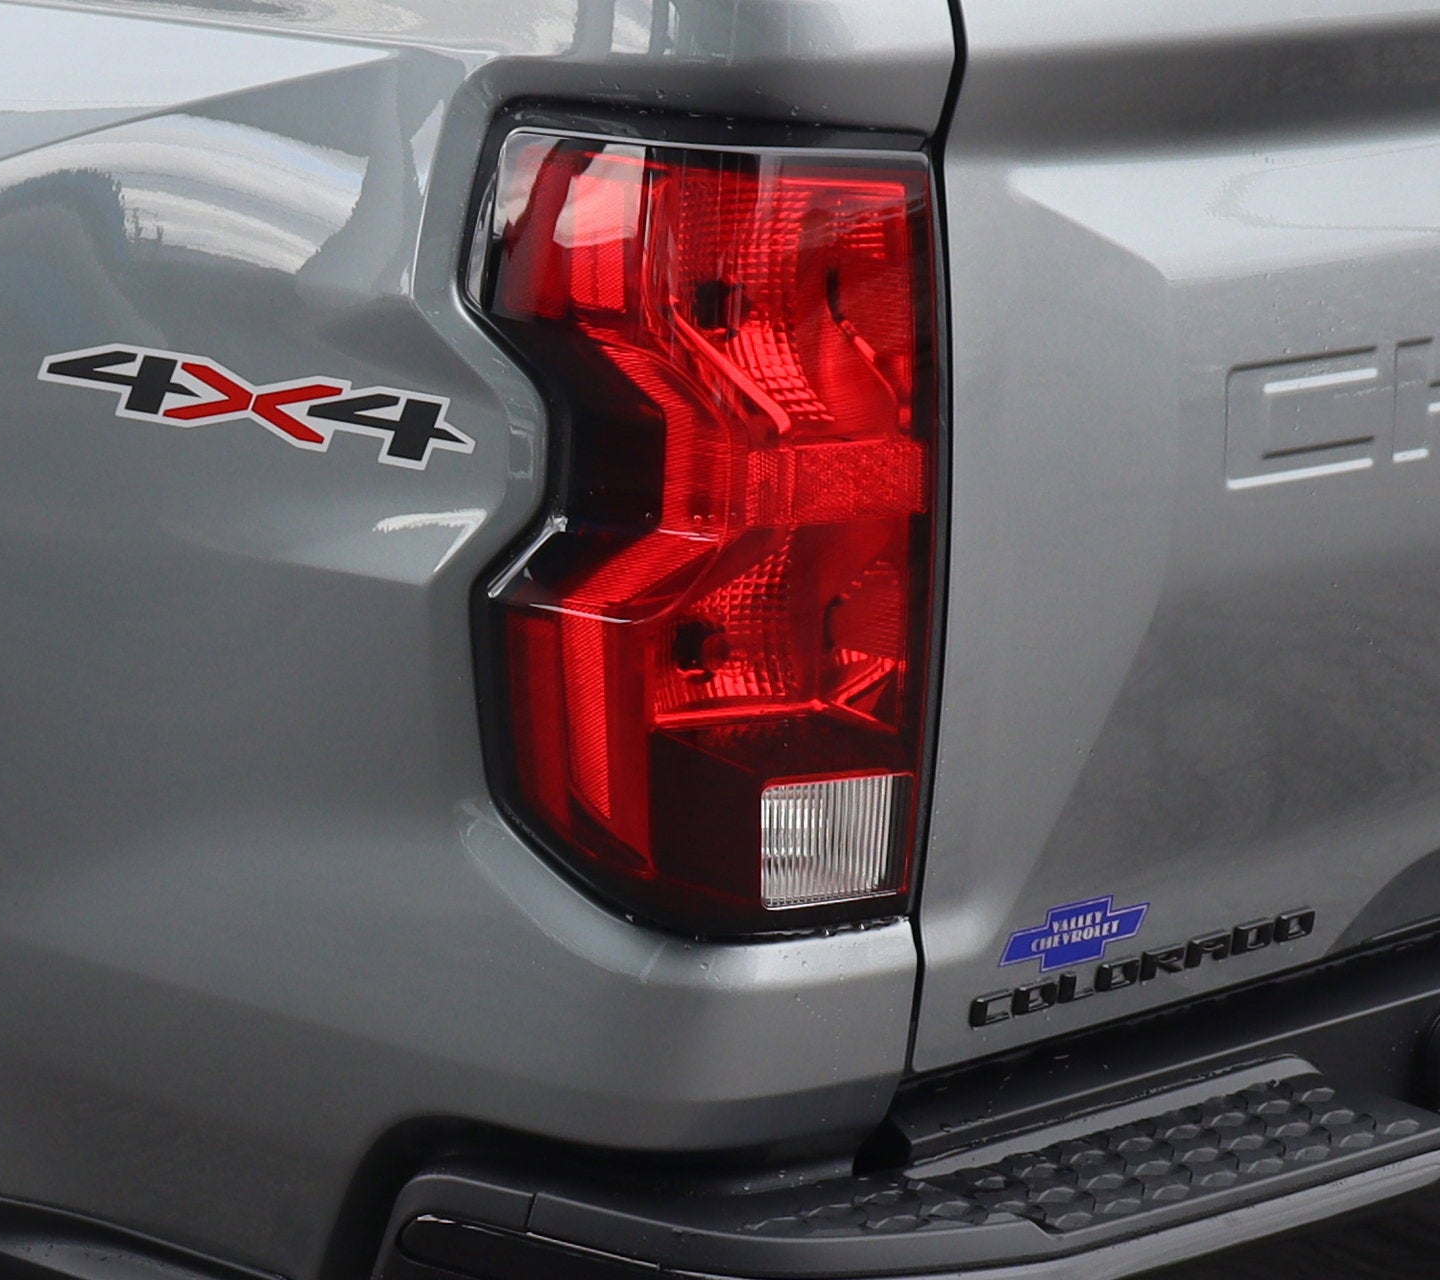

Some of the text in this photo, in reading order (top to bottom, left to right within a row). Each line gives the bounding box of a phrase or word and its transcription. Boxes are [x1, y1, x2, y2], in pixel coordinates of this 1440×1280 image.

[1030, 921, 1120, 951] CHEVROLET
[1051, 911, 1104, 934] VALLEY
[969, 906, 1316, 1029] COLORADO
